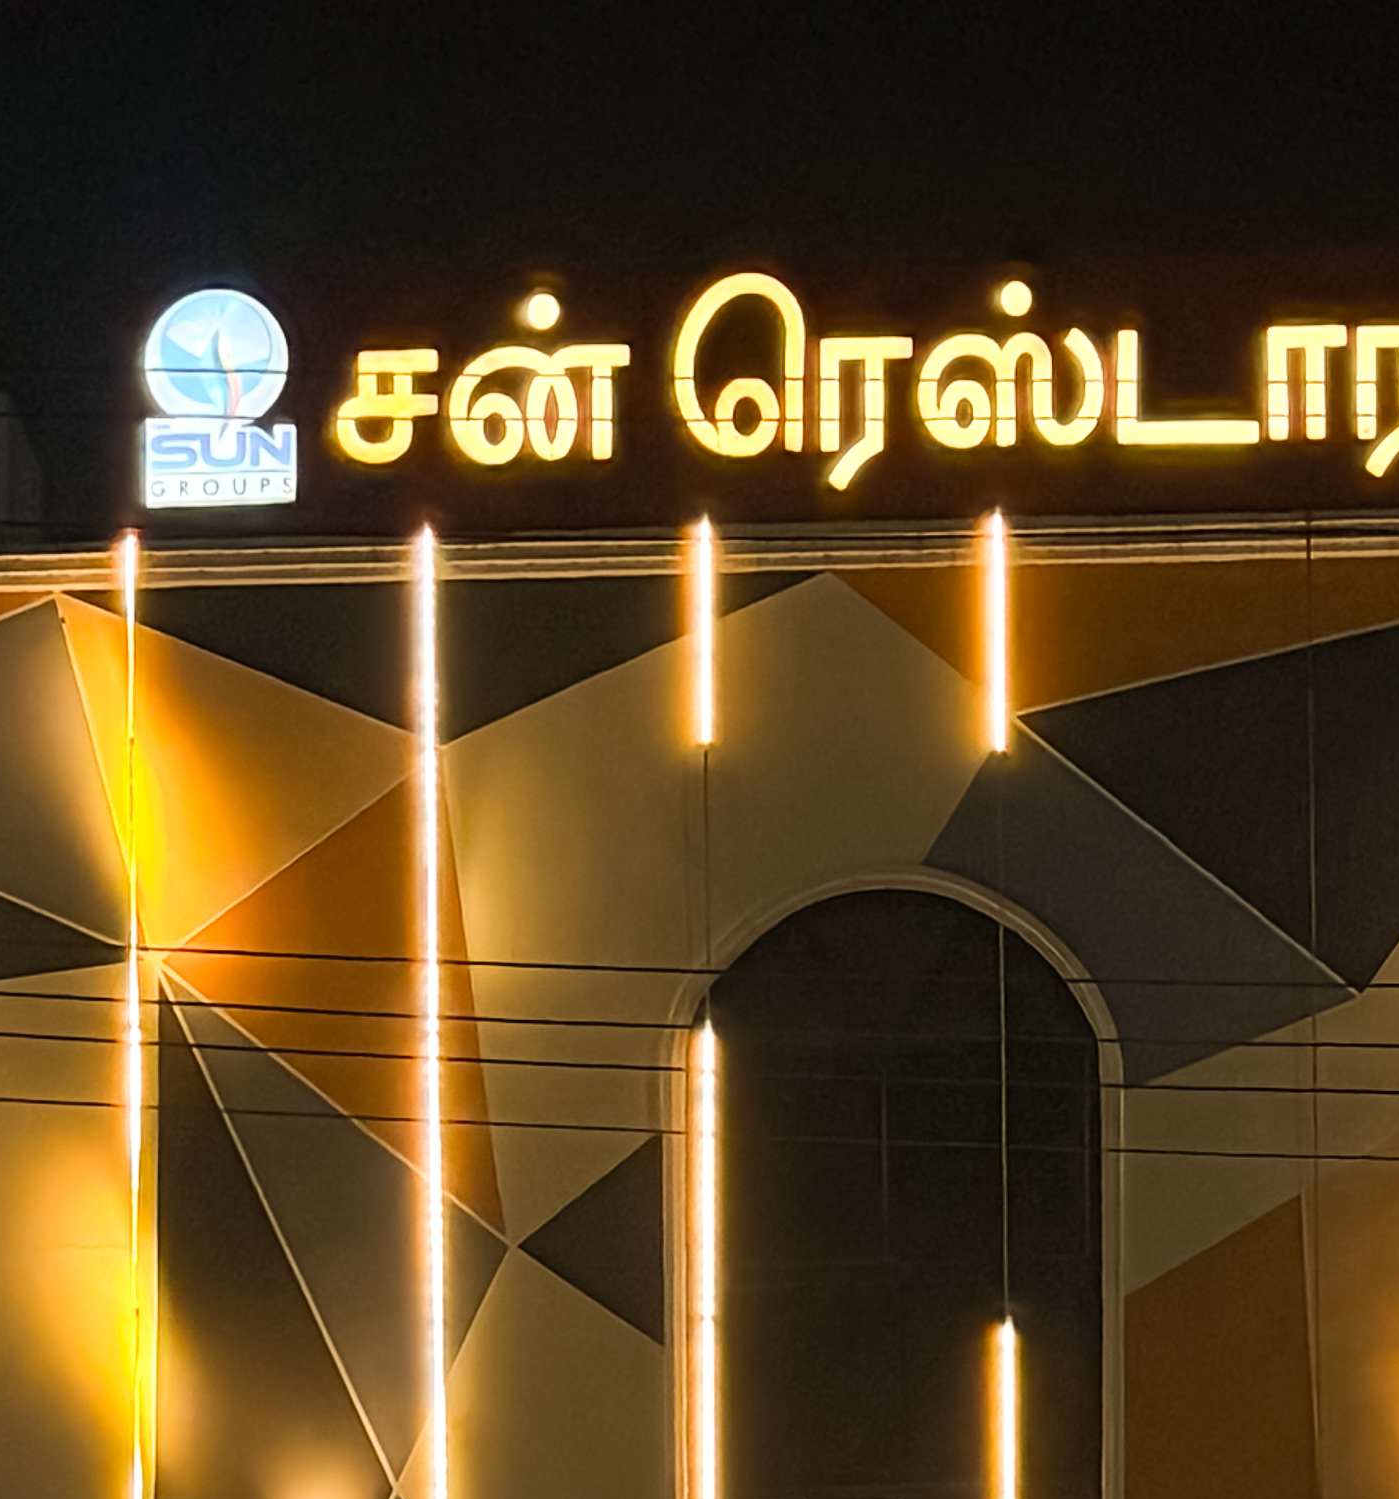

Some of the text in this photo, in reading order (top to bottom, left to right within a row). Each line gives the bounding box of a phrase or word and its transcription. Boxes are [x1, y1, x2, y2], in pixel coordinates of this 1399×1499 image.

[334, 290, 631, 466] சன்
[150, 430, 292, 470] SUN
[151, 478, 294, 498] GROUPS
